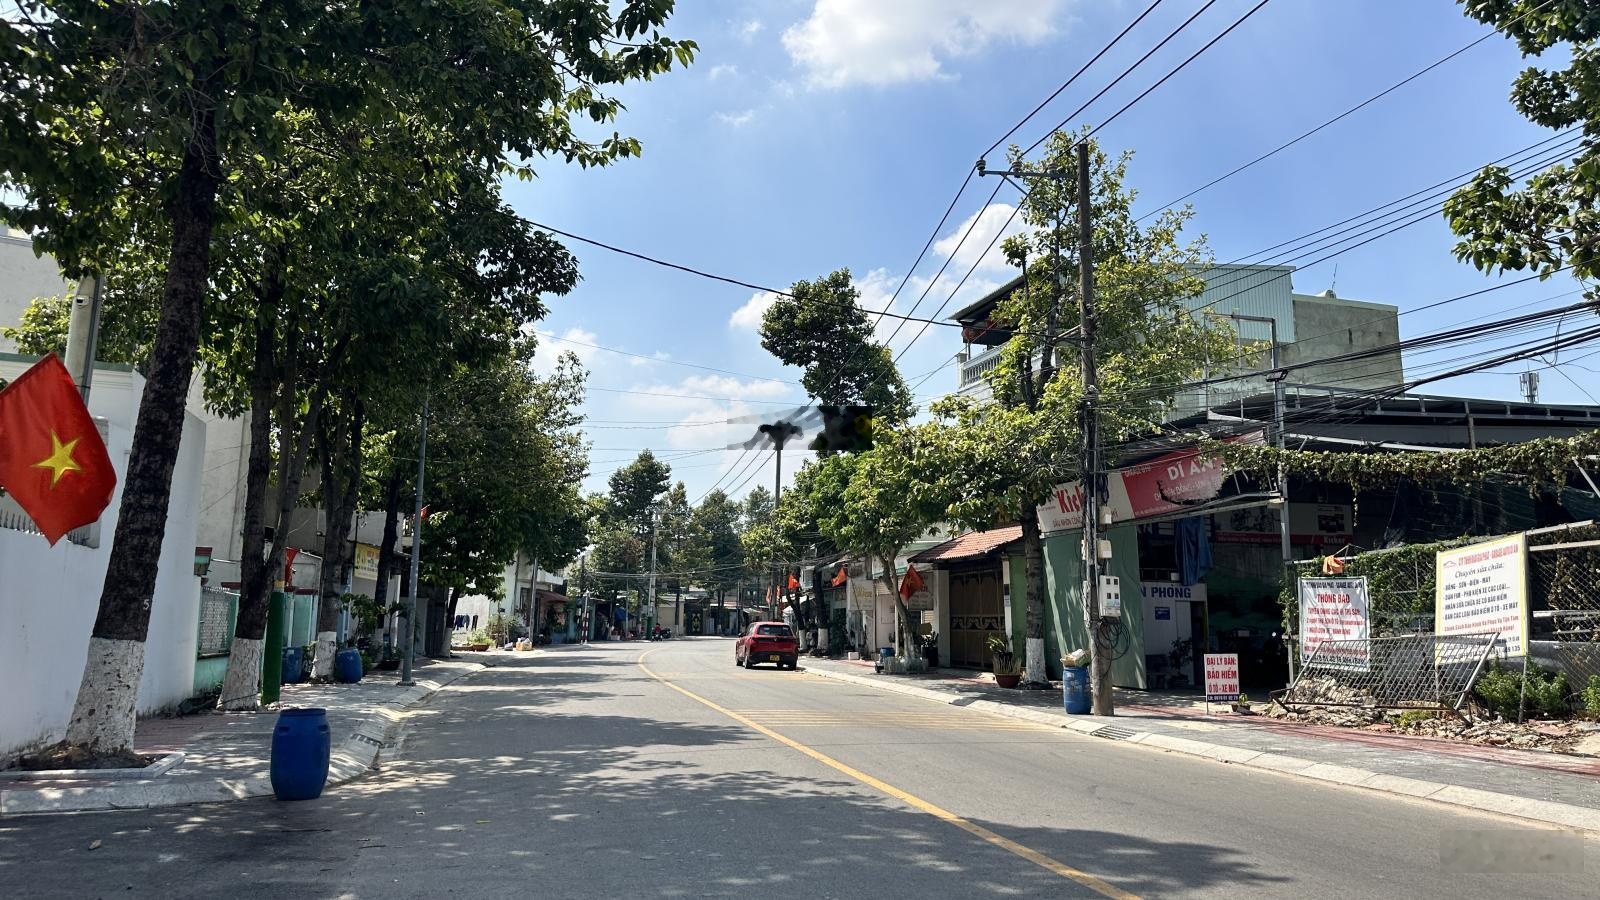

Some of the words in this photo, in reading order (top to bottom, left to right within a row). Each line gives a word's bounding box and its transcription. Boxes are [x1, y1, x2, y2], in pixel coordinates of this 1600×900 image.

[1167, 461, 1185, 481] DĨ
[1151, 583, 1191, 598] PHÒNG
[143, 598, 150, 610] 5
[1317, 593, 1336, 602] THÔNG
[1337, 593, 1350, 603] BÁO
[1207, 667, 1220, 679] BẢO
[1221, 666, 1237, 679] HIỂM
